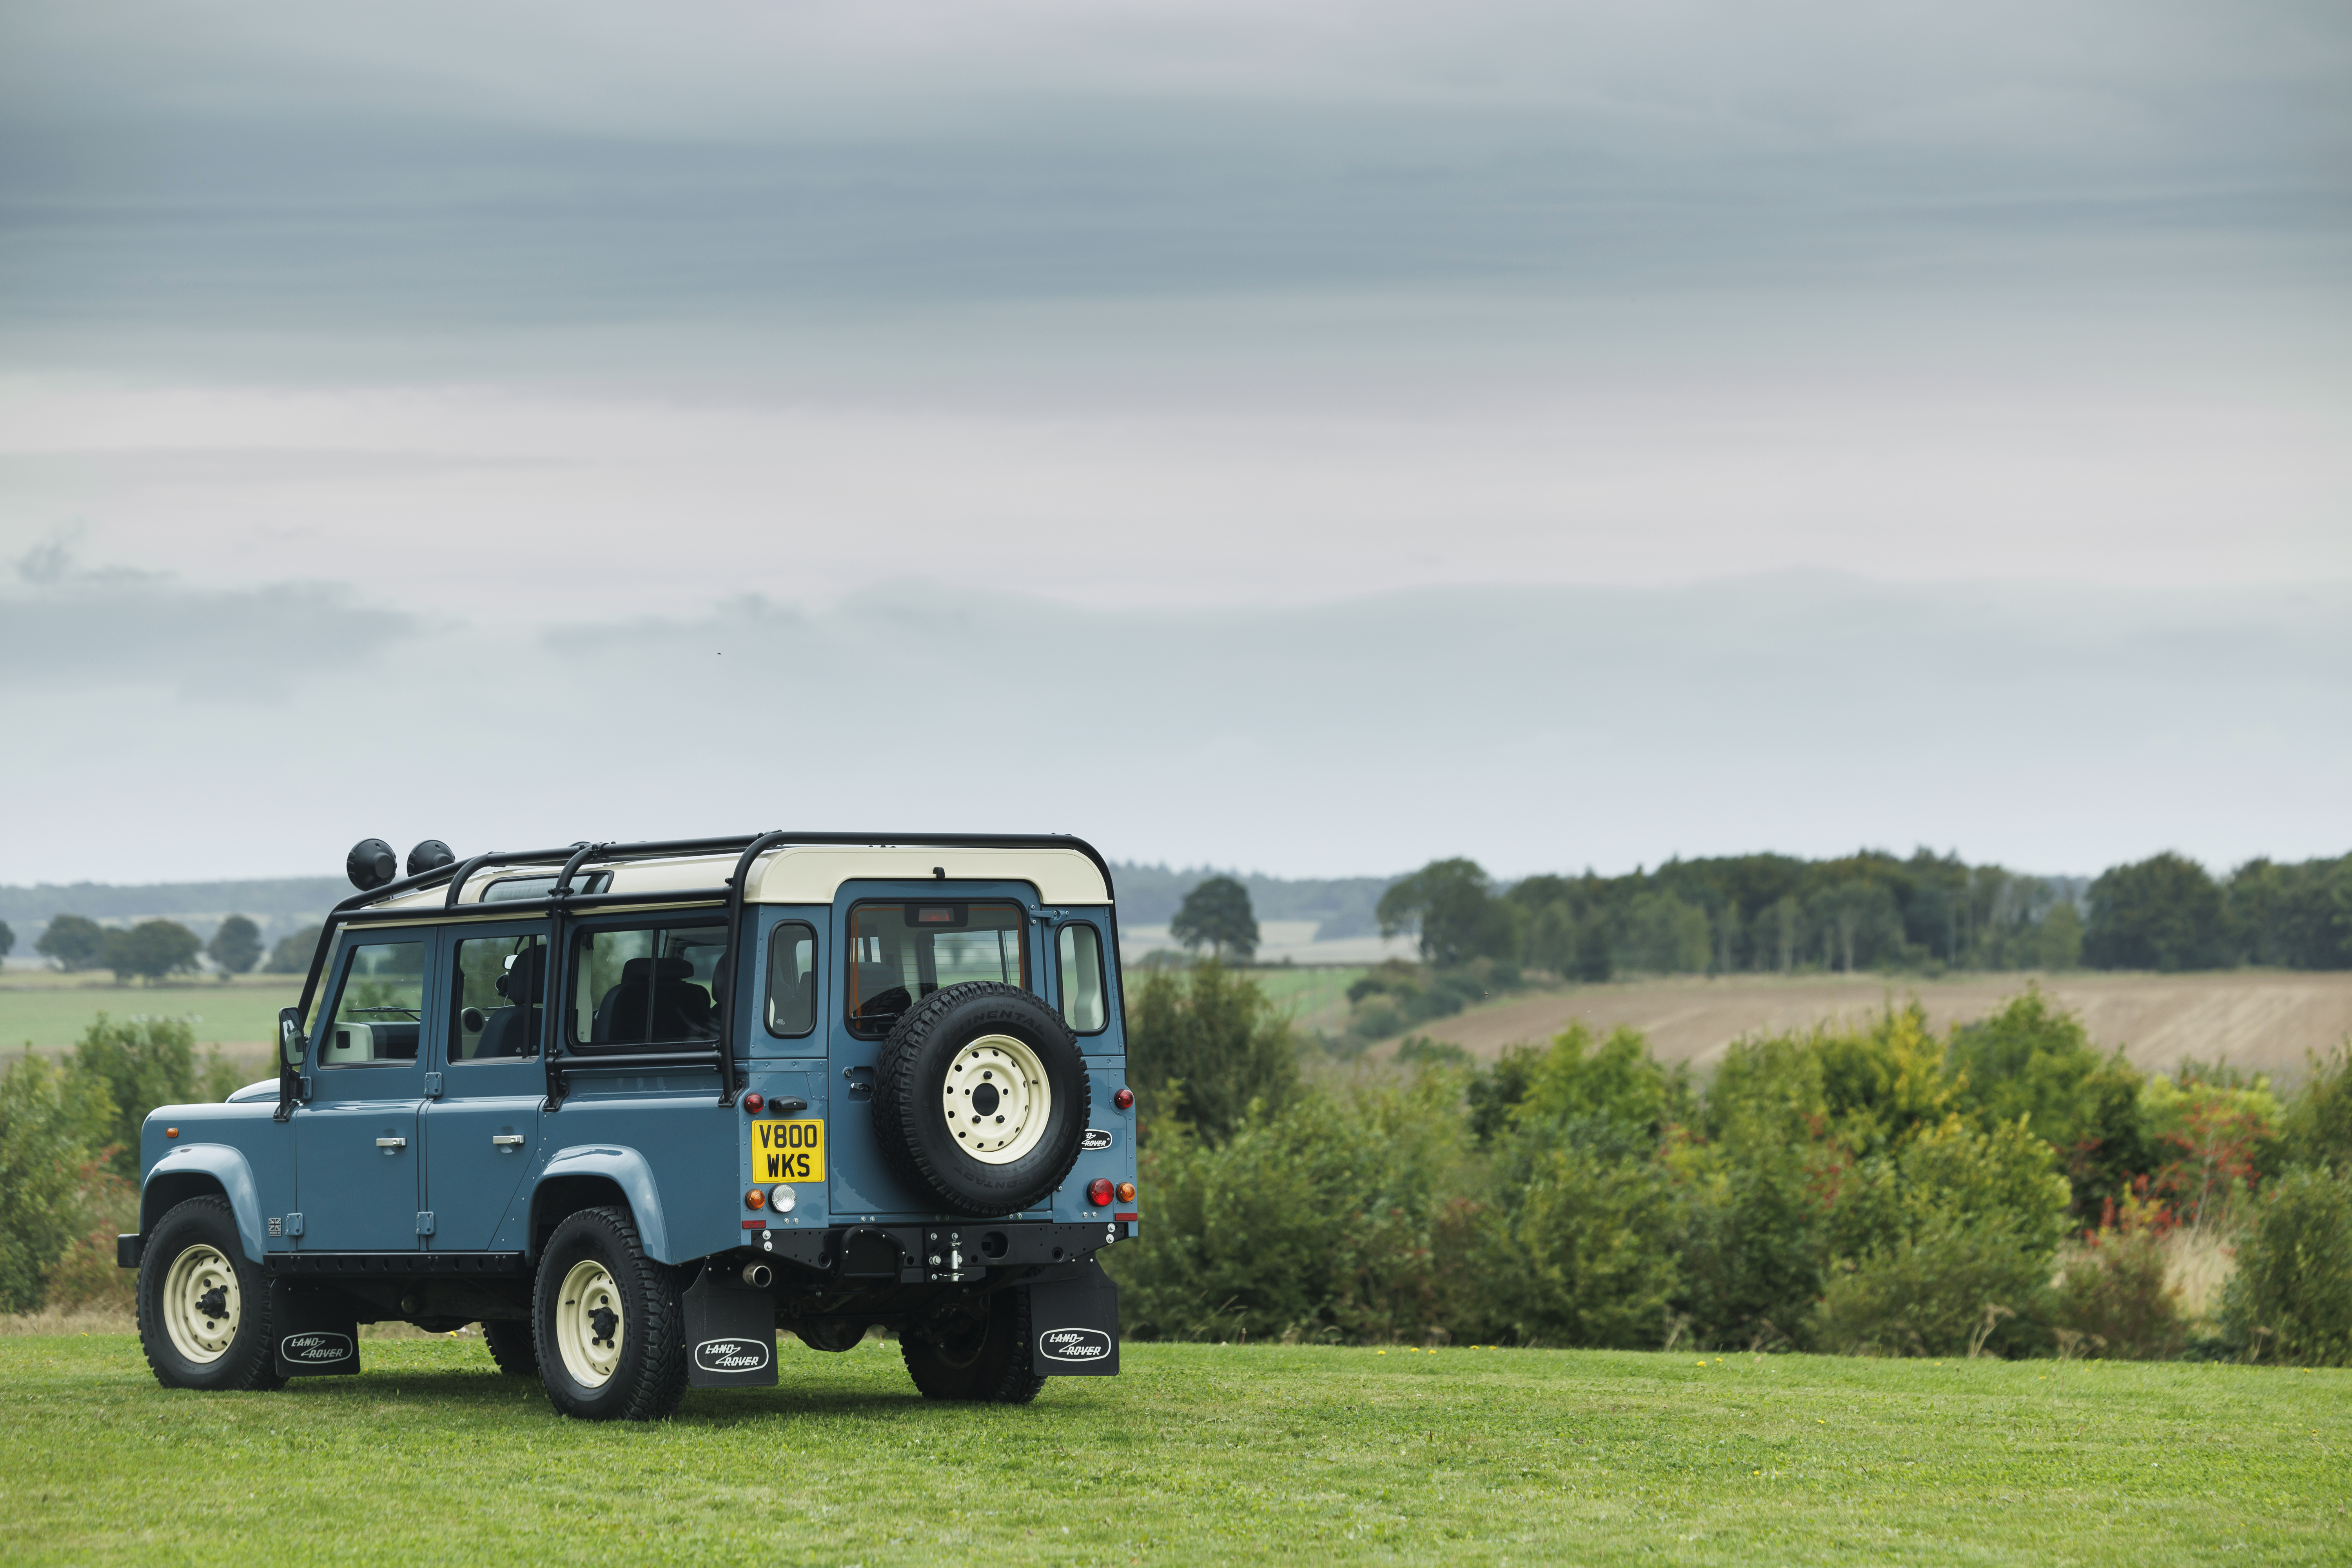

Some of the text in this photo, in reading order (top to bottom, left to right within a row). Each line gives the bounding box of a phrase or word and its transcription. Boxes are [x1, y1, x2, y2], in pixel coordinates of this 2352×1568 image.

[931, 1009, 1045, 1075] CONTINENTAL
[759, 1124, 817, 1148] V800
[767, 1154, 810, 1177] WKS
[291, 1338, 319, 1347] LAND
[1049, 1334, 1078, 1343] LAND
[309, 1348, 343, 1358] ROVER
[705, 1344, 734, 1354] LAND
[1067, 1347, 1101, 1355] ROVER
[724, 1356, 759, 1366] ROVER
